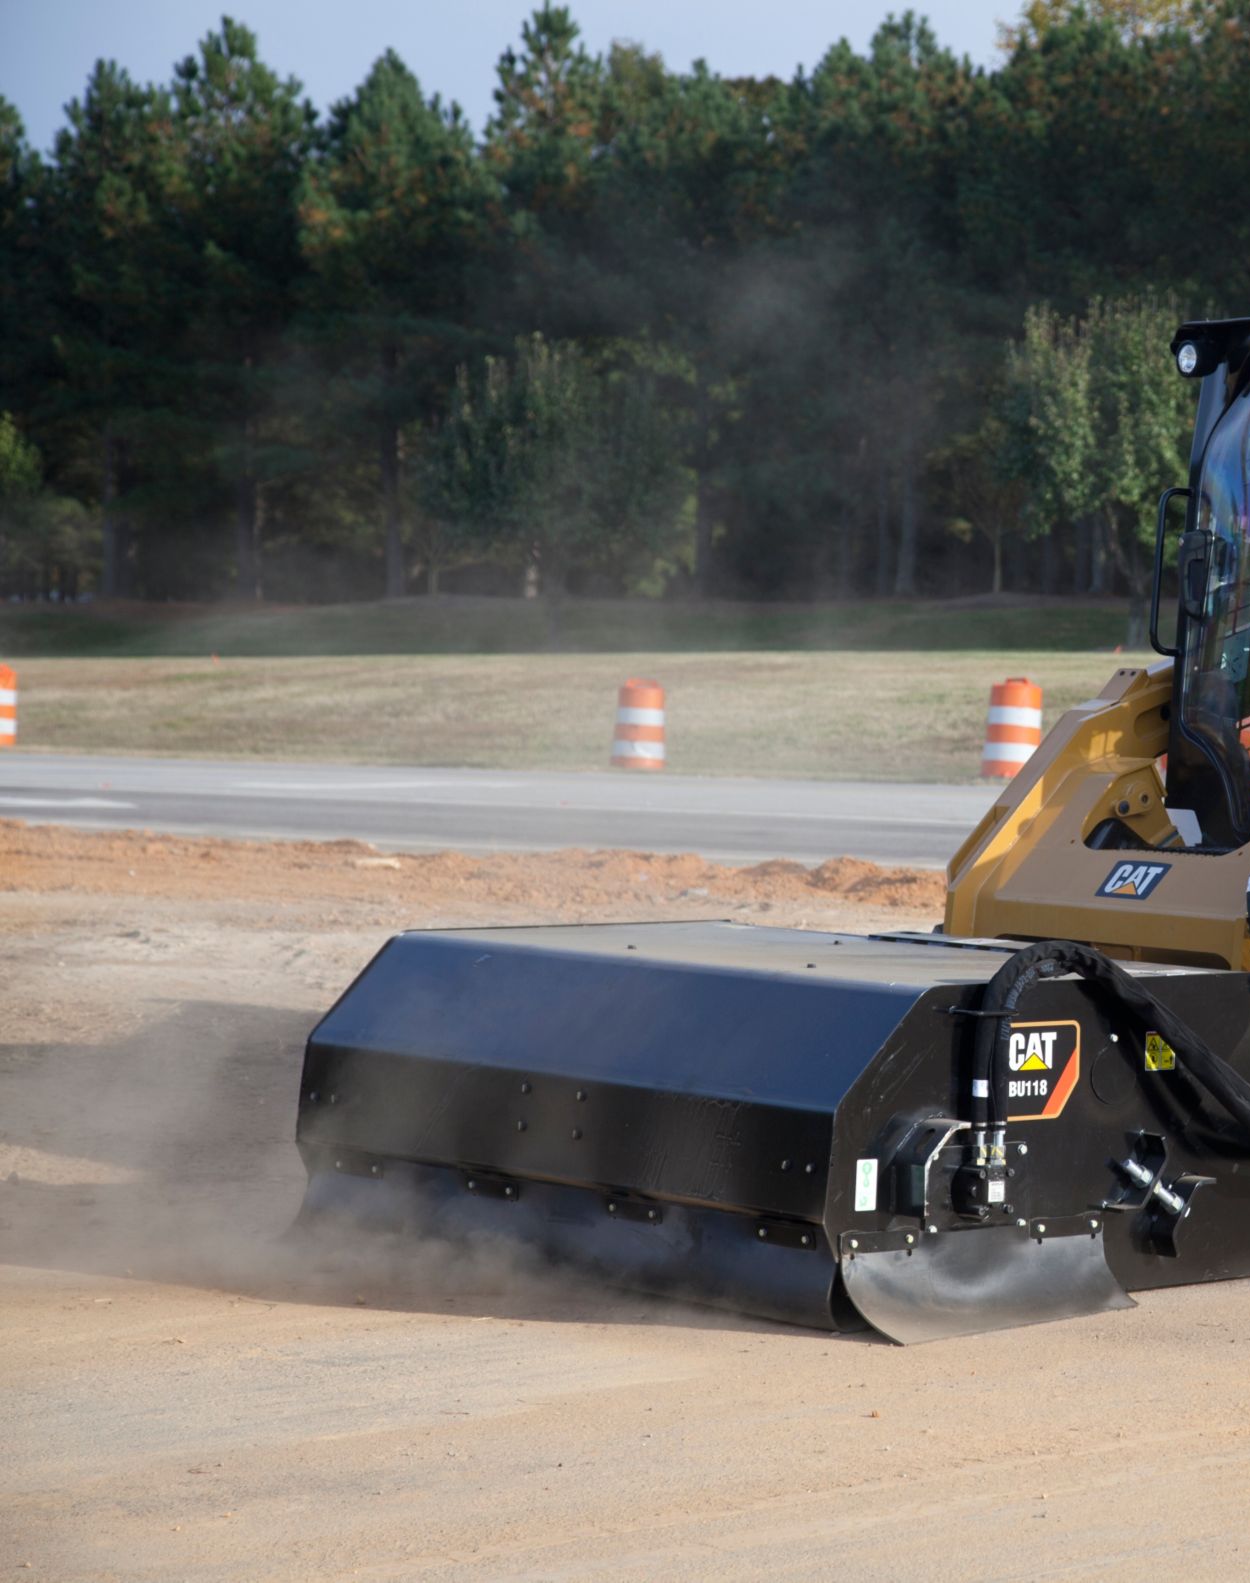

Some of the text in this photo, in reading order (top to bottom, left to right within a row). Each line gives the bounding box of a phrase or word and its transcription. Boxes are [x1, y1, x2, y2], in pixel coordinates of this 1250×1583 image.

[1104, 864, 1164, 895] CAT
[1009, 1031, 1057, 1071] CAT
[1008, 1079, 1048, 1097] BU118
